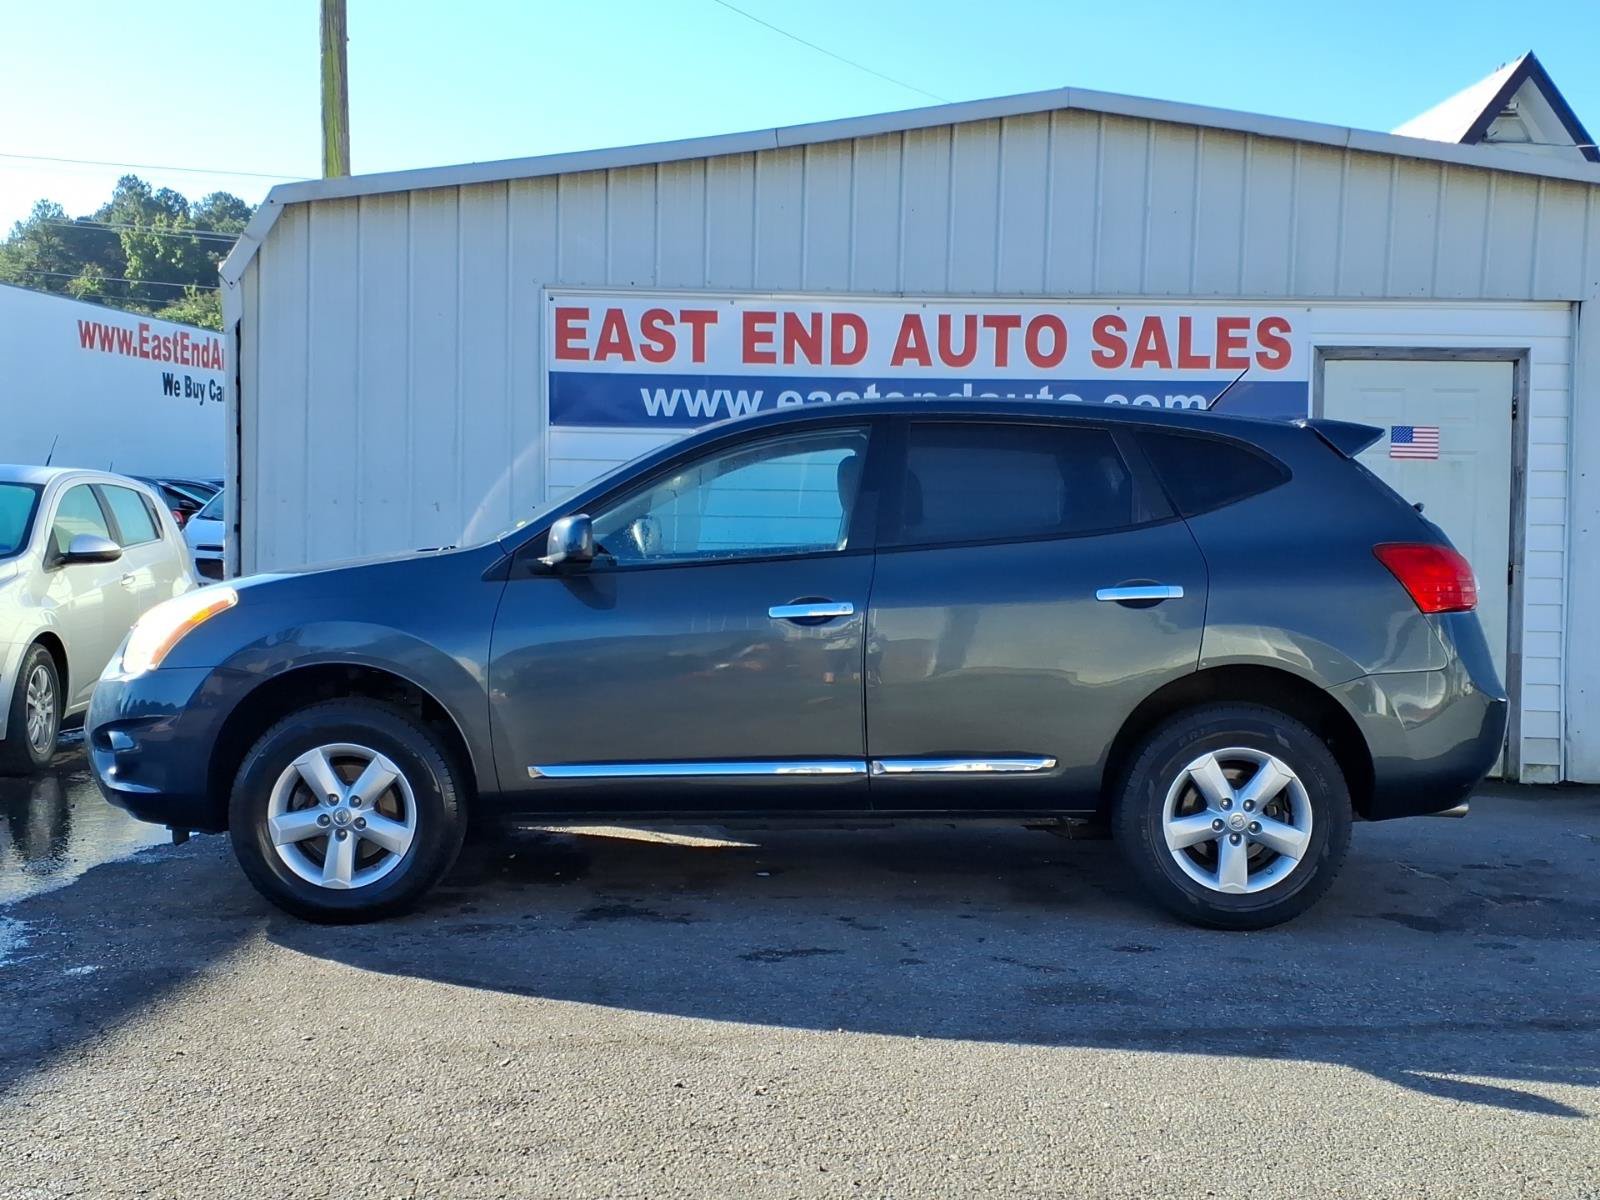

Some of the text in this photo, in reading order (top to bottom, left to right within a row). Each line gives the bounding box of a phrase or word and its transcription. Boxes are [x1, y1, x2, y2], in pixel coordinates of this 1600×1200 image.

[77, 319, 224, 370] www.EastEndA
[555, 306, 1292, 370] EAST END AUTO SALES
[162, 372, 224, 406] We Buy Ca
